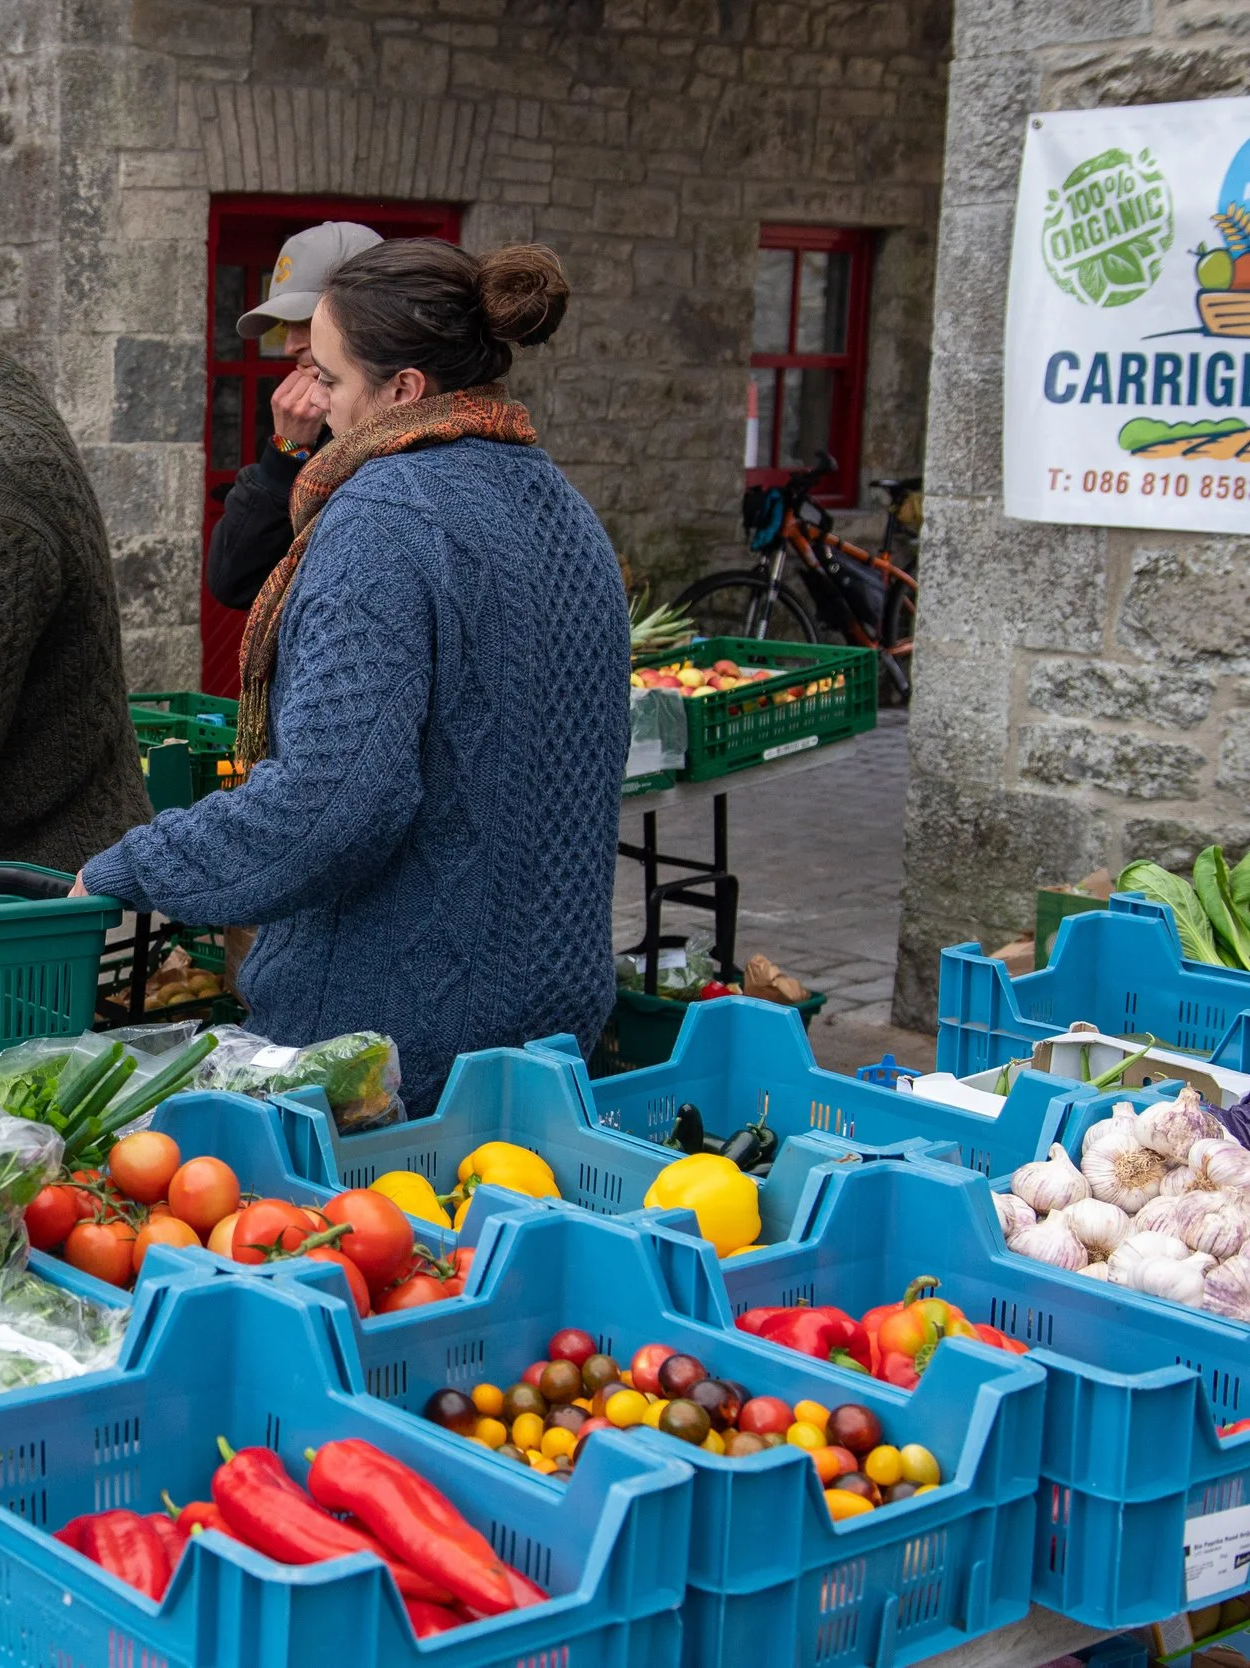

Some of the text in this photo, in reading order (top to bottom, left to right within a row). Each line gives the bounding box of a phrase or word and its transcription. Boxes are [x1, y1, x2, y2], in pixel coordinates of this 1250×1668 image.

[1065, 169, 1136, 220] 100%
[1050, 186, 1165, 260] ORGANIC
[1044, 351, 1250, 406] CARRIG
[1048, 468, 1250, 500] T: 086 810 858
